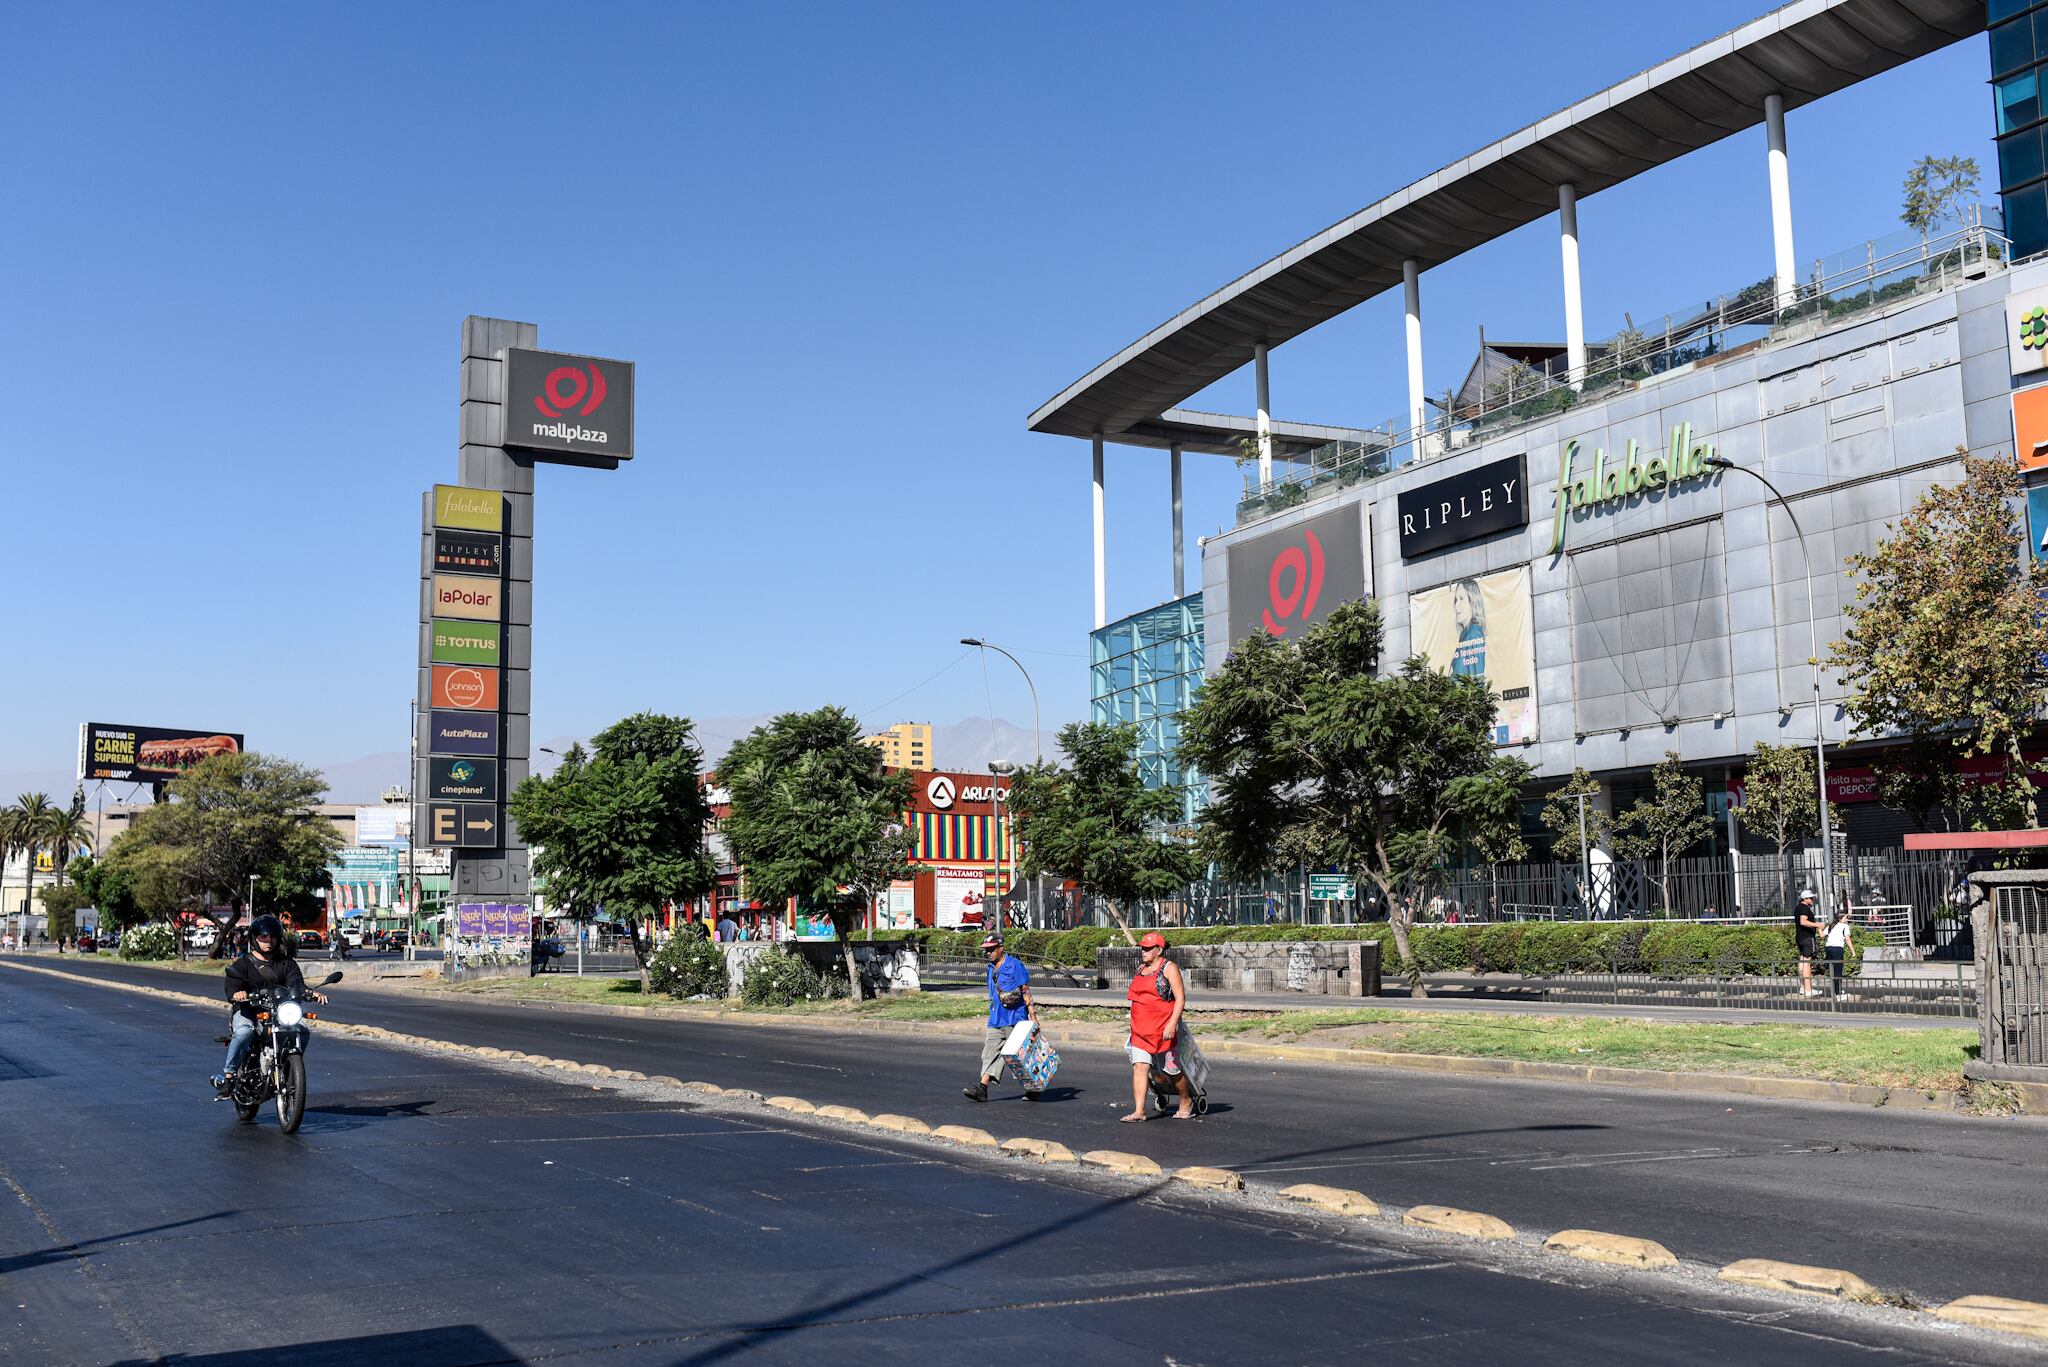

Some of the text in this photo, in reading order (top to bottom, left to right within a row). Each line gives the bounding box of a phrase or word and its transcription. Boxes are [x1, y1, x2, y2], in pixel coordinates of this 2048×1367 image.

[533, 422, 608, 444] mallplaza
[1546, 421, 1714, 556] falabella
[1403, 479, 1516, 536] RIPLEY
[441, 544, 489, 556] RIPLEY
[439, 588, 493, 606] laPolar
[448, 636, 497, 650] TOTTUS
[448, 682, 482, 692] Johnson
[95, 730, 115, 740] NUEVO
[115, 731, 128, 740] SUB
[440, 728, 489, 739] AutoPlaza
[94, 738, 135, 755] CARNE
[93, 752, 135, 765] SUPREMA
[93, 768, 132, 779] SUBWAY
[441, 785, 485, 795] cineplanet
[434, 808, 457, 841] E
[937, 870, 984, 878] REMATAMOS
